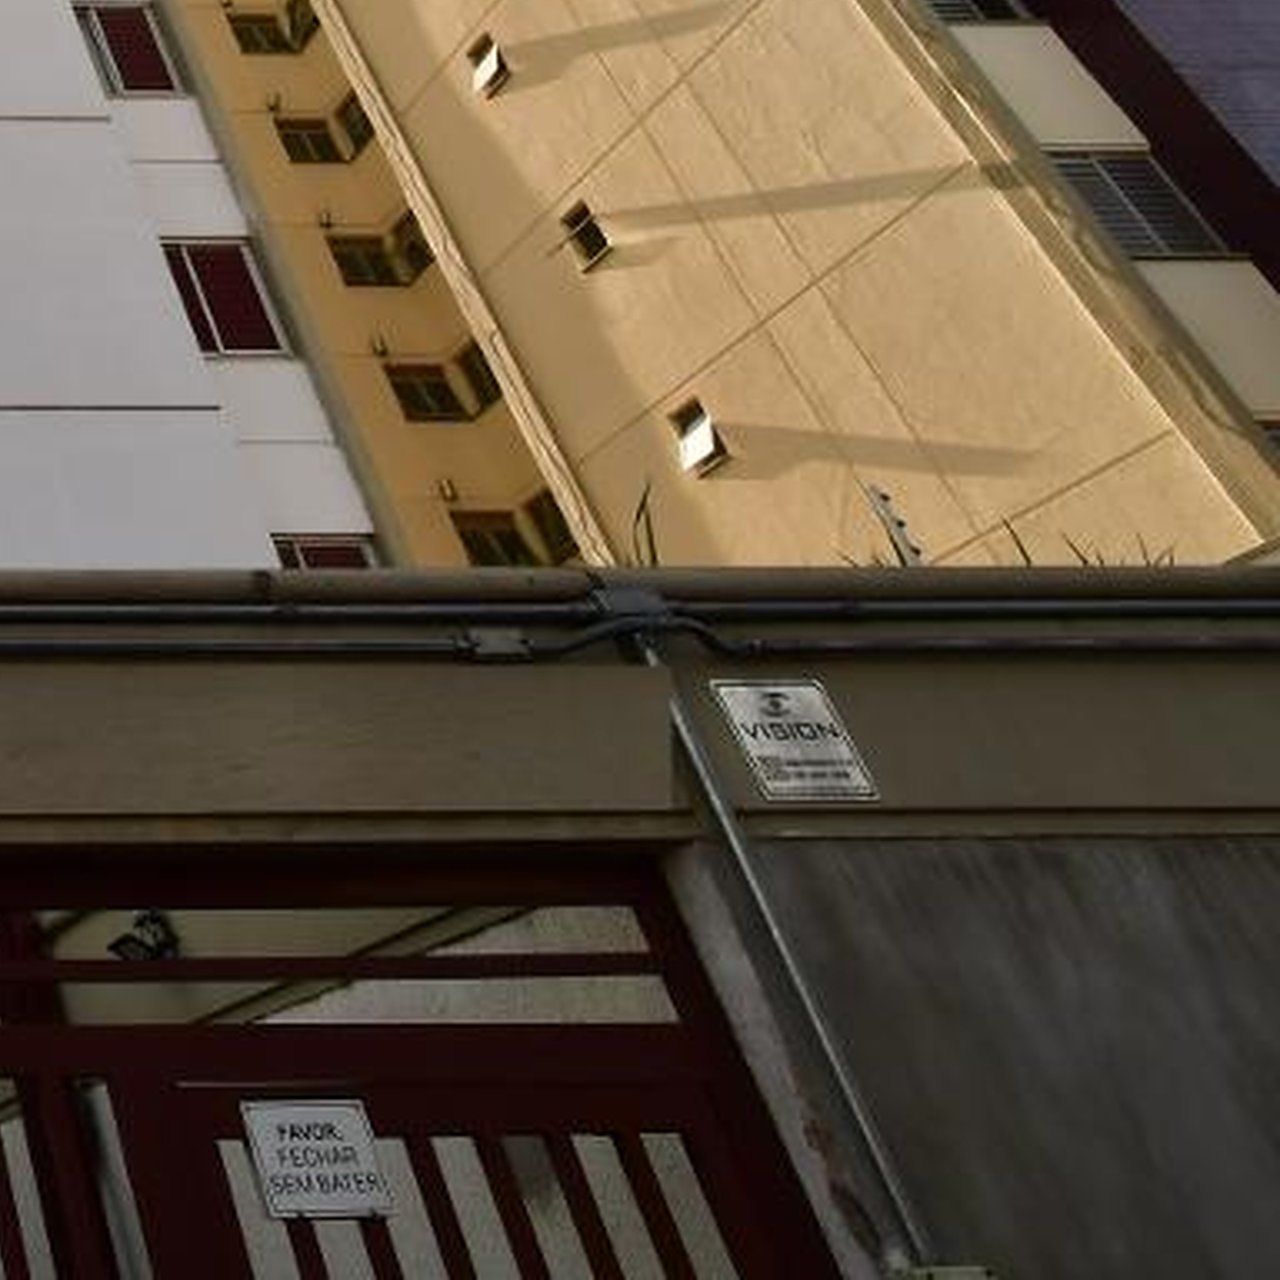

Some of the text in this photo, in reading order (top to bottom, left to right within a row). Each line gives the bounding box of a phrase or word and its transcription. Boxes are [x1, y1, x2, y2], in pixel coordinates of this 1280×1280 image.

[740, 722, 839, 741] VISION
[277, 1145, 360, 1168] FECHAR
[269, 1172, 383, 1195] SEM BATER
